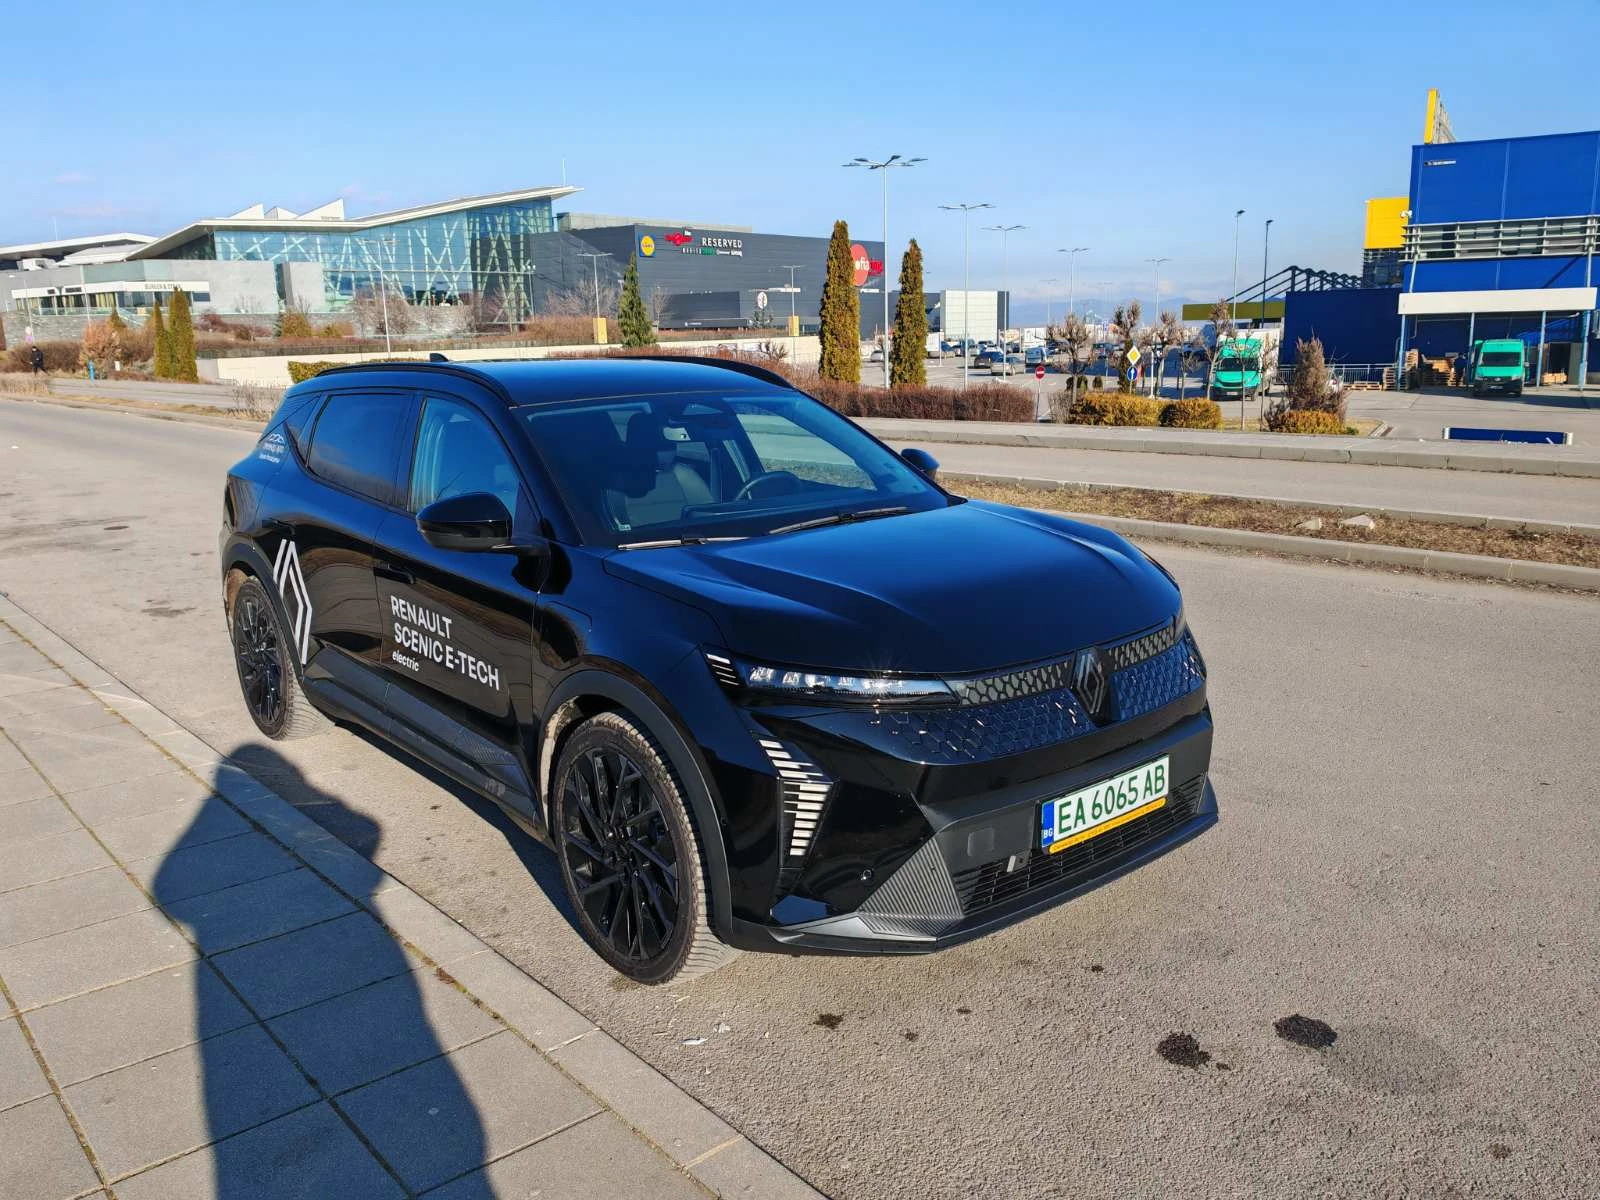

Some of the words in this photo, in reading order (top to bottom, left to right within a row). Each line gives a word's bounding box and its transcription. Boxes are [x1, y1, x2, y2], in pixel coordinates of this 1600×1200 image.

[701, 237, 743, 249] RESERVED
[390, 595, 453, 640] RENAULT
[392, 649, 420, 672] electric
[394, 622, 443, 663] SCENIC
[445, 645, 500, 691] E-TECH
[1058, 797, 1087, 834] EA
[1091, 775, 1138, 821] 6065
[1143, 764, 1165, 800] AB
[1043, 827, 1053, 839] BG
